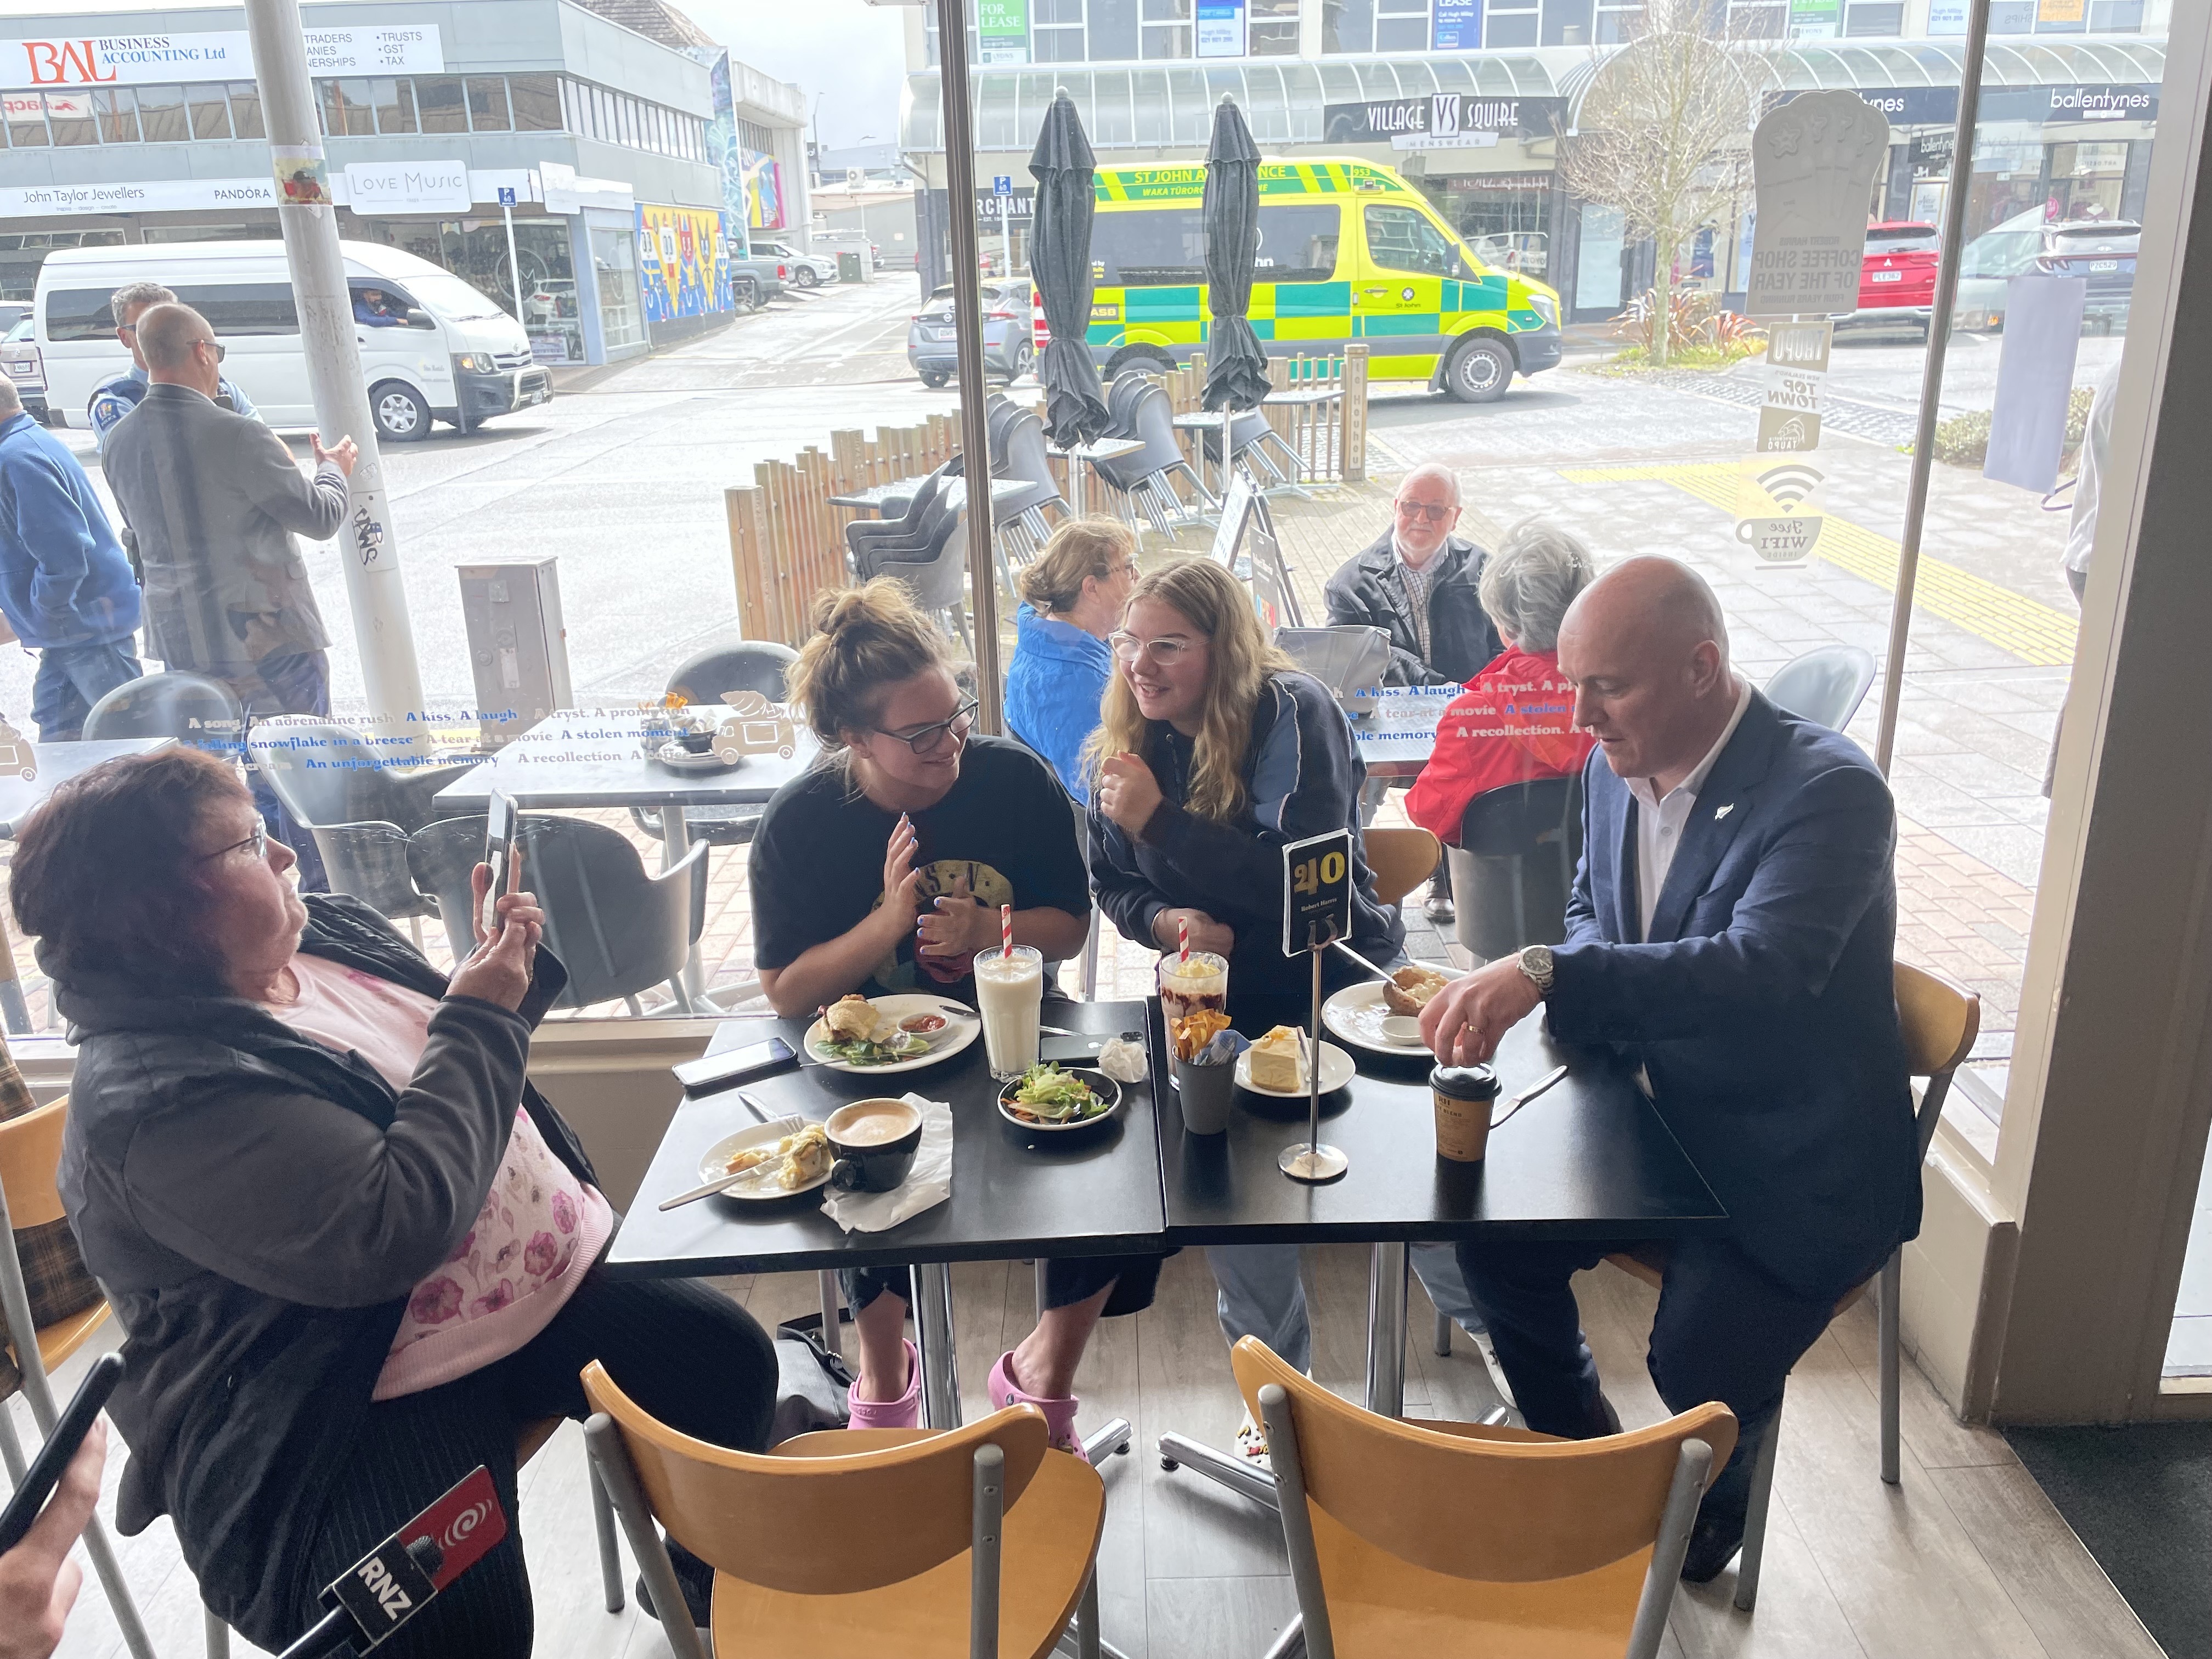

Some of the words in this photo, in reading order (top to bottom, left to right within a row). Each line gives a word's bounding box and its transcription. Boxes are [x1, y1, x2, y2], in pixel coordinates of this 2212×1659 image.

[981, 4, 1006, 15] FOR
[981, 16, 1020, 27] LEASE
[99, 37, 170, 50] BUSINESS
[304, 33, 352, 43] TRADERS
[381, 31, 422, 42] TRUSTS
[102, 49, 200, 64] ACCOUNTING
[204, 47, 225, 60] Ltd
[307, 46, 336, 55] ANIES
[384, 44, 404, 53] GST
[21, 40, 117, 84] BAL
[308, 58, 356, 67] NERSHIPS
[385, 57, 405, 65] TAX
[2050, 88, 2149, 110] ballentynes
[1367, 105, 1425, 132] VILLAGE
[1468, 103, 1520, 129] SQUIRE
[1436, 97, 1458, 133] VS
[1409, 139, 1480, 148] MENSWEAR
[1921, 136, 1954, 153] ballentyne
[1135, 171, 1151, 184] ST
[1154, 170, 1192, 183] JOHN
[1258, 166, 1286, 178] NCE
[1353, 168, 1370, 177] 953
[24, 191, 51, 203] John
[53, 190, 88, 204] Taylor
[91, 187, 144, 201] Jewellers
[214, 188, 272, 199] PANDORA
[1142, 187, 1168, 196] WAKA
[977, 198, 1036, 215] RCHANT
[1255, 257, 1274, 267] hn
[1090, 308, 1116, 317] ASB
[101, 414, 117, 427] POLICE
[1256, 594, 1276, 629] OPEN
[1355, 688, 1367, 697] A
[1409, 686, 1419, 695] A
[1425, 684, 1465, 699] laugh
[1483, 681, 1493, 693] A
[1498, 681, 1537, 696] tryst.
[1542, 680, 1553, 691] A
[189, 718, 201, 729] A
[249, 716, 271, 727] An
[275, 715, 355, 726] adrenaline
[359, 713, 395, 724] rush
[407, 712, 417, 722] A
[421, 711, 454, 721] kiss.
[460, 710, 471, 720] A
[476, 709, 518, 724] laugh
[534, 708, 546, 719] A
[550, 708, 589, 723] tryst.
[595, 708, 606, 717] A
[1370, 709, 1380, 719] A
[1386, 708, 1413, 718] tear
[1419, 707, 1434, 716] at
[1451, 704, 1496, 716] movie
[1505, 703, 1515, 714] A
[1520, 702, 1566, 713] stolen
[251, 737, 327, 751] snowflake
[333, 737, 348, 747] in
[365, 735, 413, 746] breeze
[427, 735, 437, 744] A
[441, 735, 471, 744] tear
[476, 733, 491, 743] at
[494, 735, 504, 743] a
[506, 731, 552, 742] movie
[561, 730, 573, 740] A
[577, 729, 622, 739] stolen
[627, 727, 690, 738] moment
[1379, 731, 1438, 742] memory
[1456, 726, 1468, 738] A
[1472, 724, 1564, 737] recollection.
[307, 759, 328, 768] An
[332, 755, 433, 771] unforgettable
[438, 756, 499, 768] memory
[518, 753, 529, 763] A
[631, 750, 642, 760] A
[646, 748, 691, 763] coffee
[1294, 851, 1345, 896] 40
[1301, 902, 1319, 912] Robert
[1320, 897, 1337, 907] Harris
[1443, 1108, 1462, 1117] BLEND
[357, 1556, 412, 1622] RNZ
